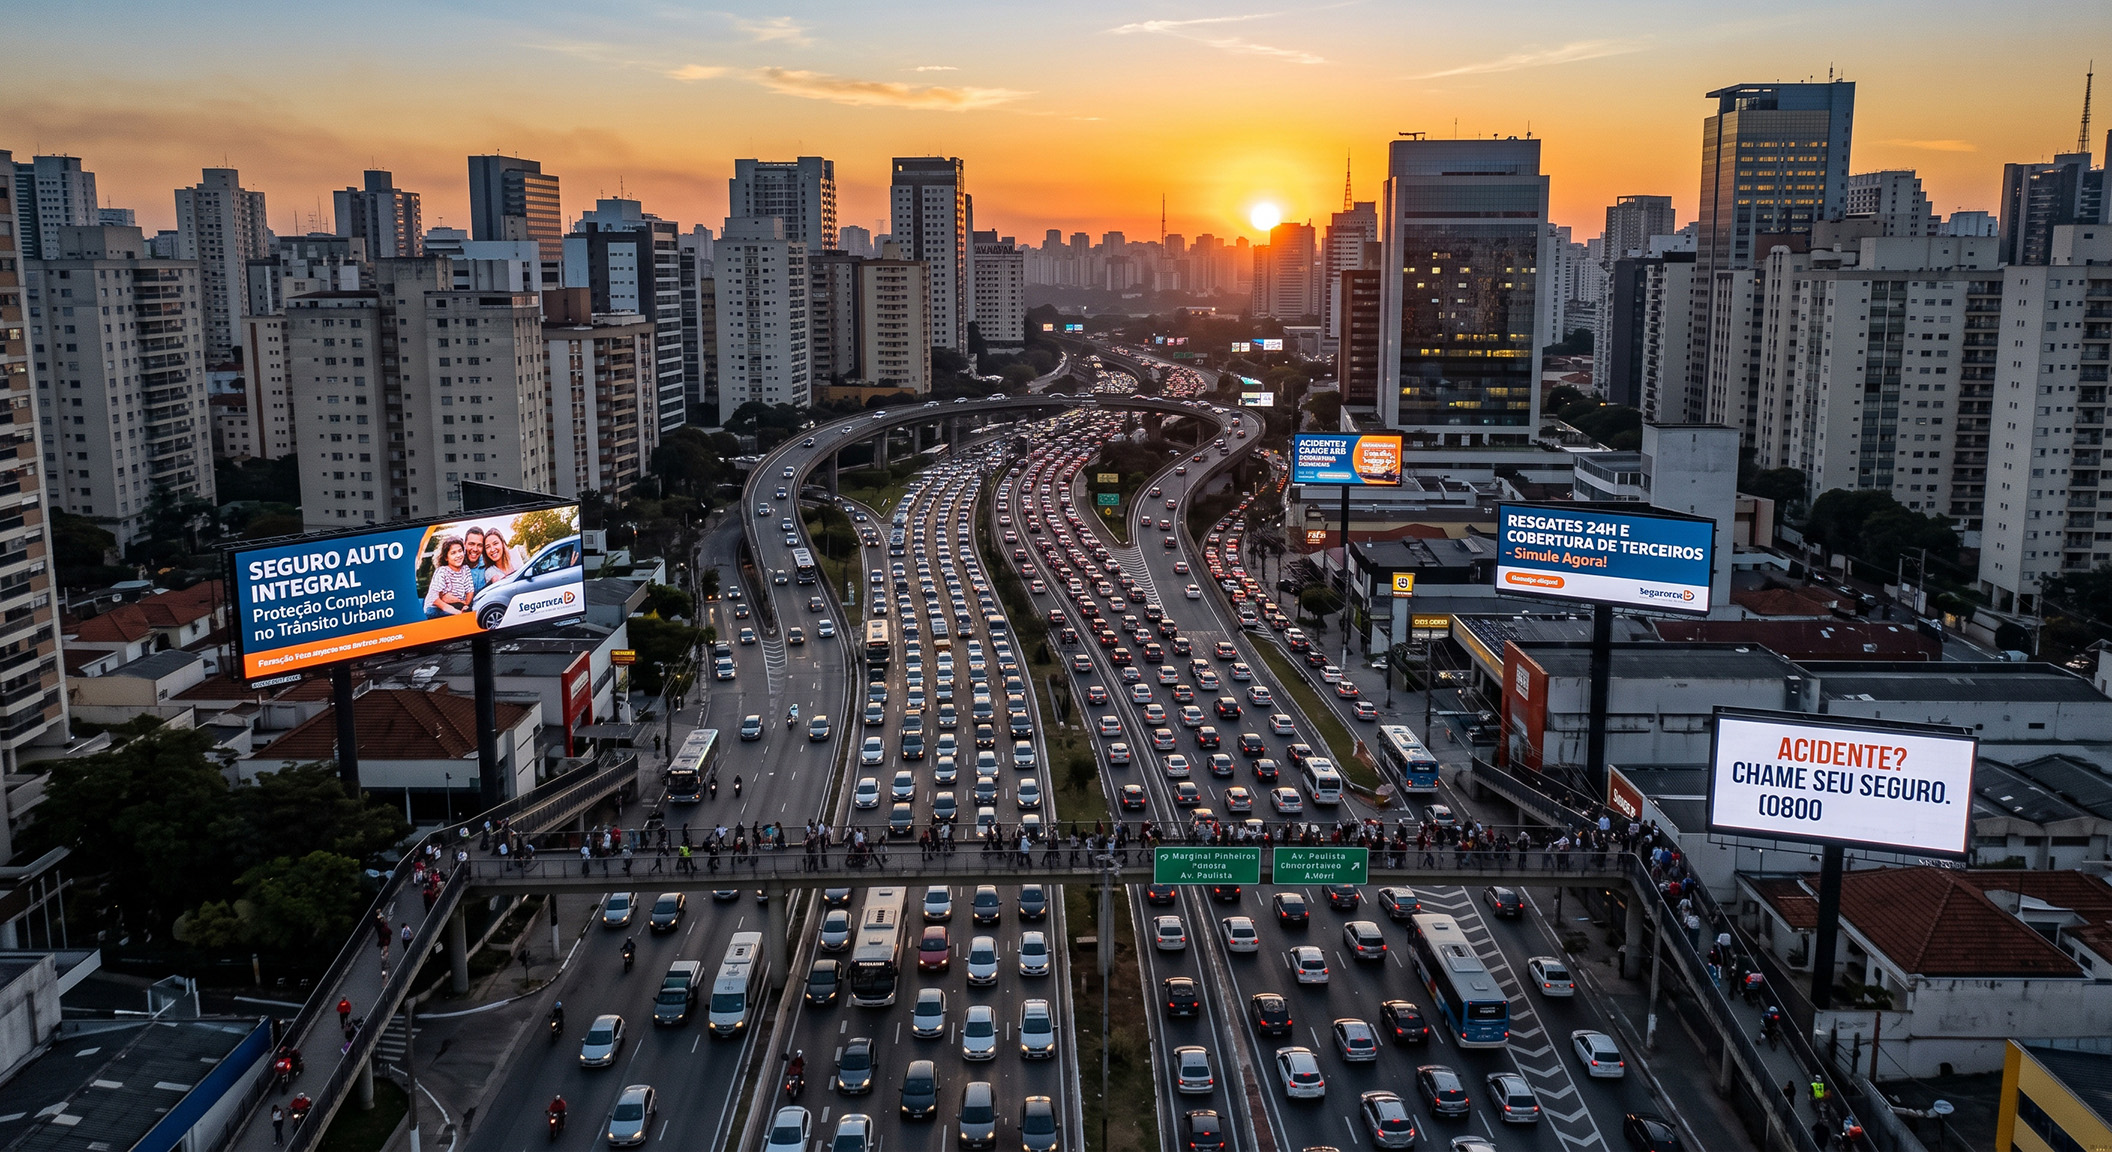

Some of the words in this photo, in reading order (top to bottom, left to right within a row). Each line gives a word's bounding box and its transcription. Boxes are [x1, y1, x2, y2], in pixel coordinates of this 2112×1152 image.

[1508, 515, 1582, 533] RESGATES
[1586, 521, 1616, 536] 24H
[1621, 524, 1630, 537] E
[248, 551, 341, 580] SEGURO
[346, 541, 404, 566] AUTO
[1507, 530, 1594, 550] COBERTURA
[1597, 538, 1616, 552] DE
[1620, 541, 1704, 560] TERCEIROS
[1514, 547, 1559, 562] Simule
[1562, 554, 1608, 569] Agora!
[251, 570, 361, 603] INTEGRAL
[253, 598, 322, 623] Proteção
[326, 588, 395, 614] Completa
[254, 624, 275, 641] no
[278, 615, 338, 639] Trânsito
[342, 606, 394, 631] Urbano
[1777, 737, 1908, 771] ACIDENTE?
[1732, 761, 1807, 790] CHAME
[1812, 769, 1854, 794] SEU
[1859, 774, 1951, 805] SEGURO.
[1758, 794, 1823, 821] (0800
[1172, 853, 1211, 861] Marginal
